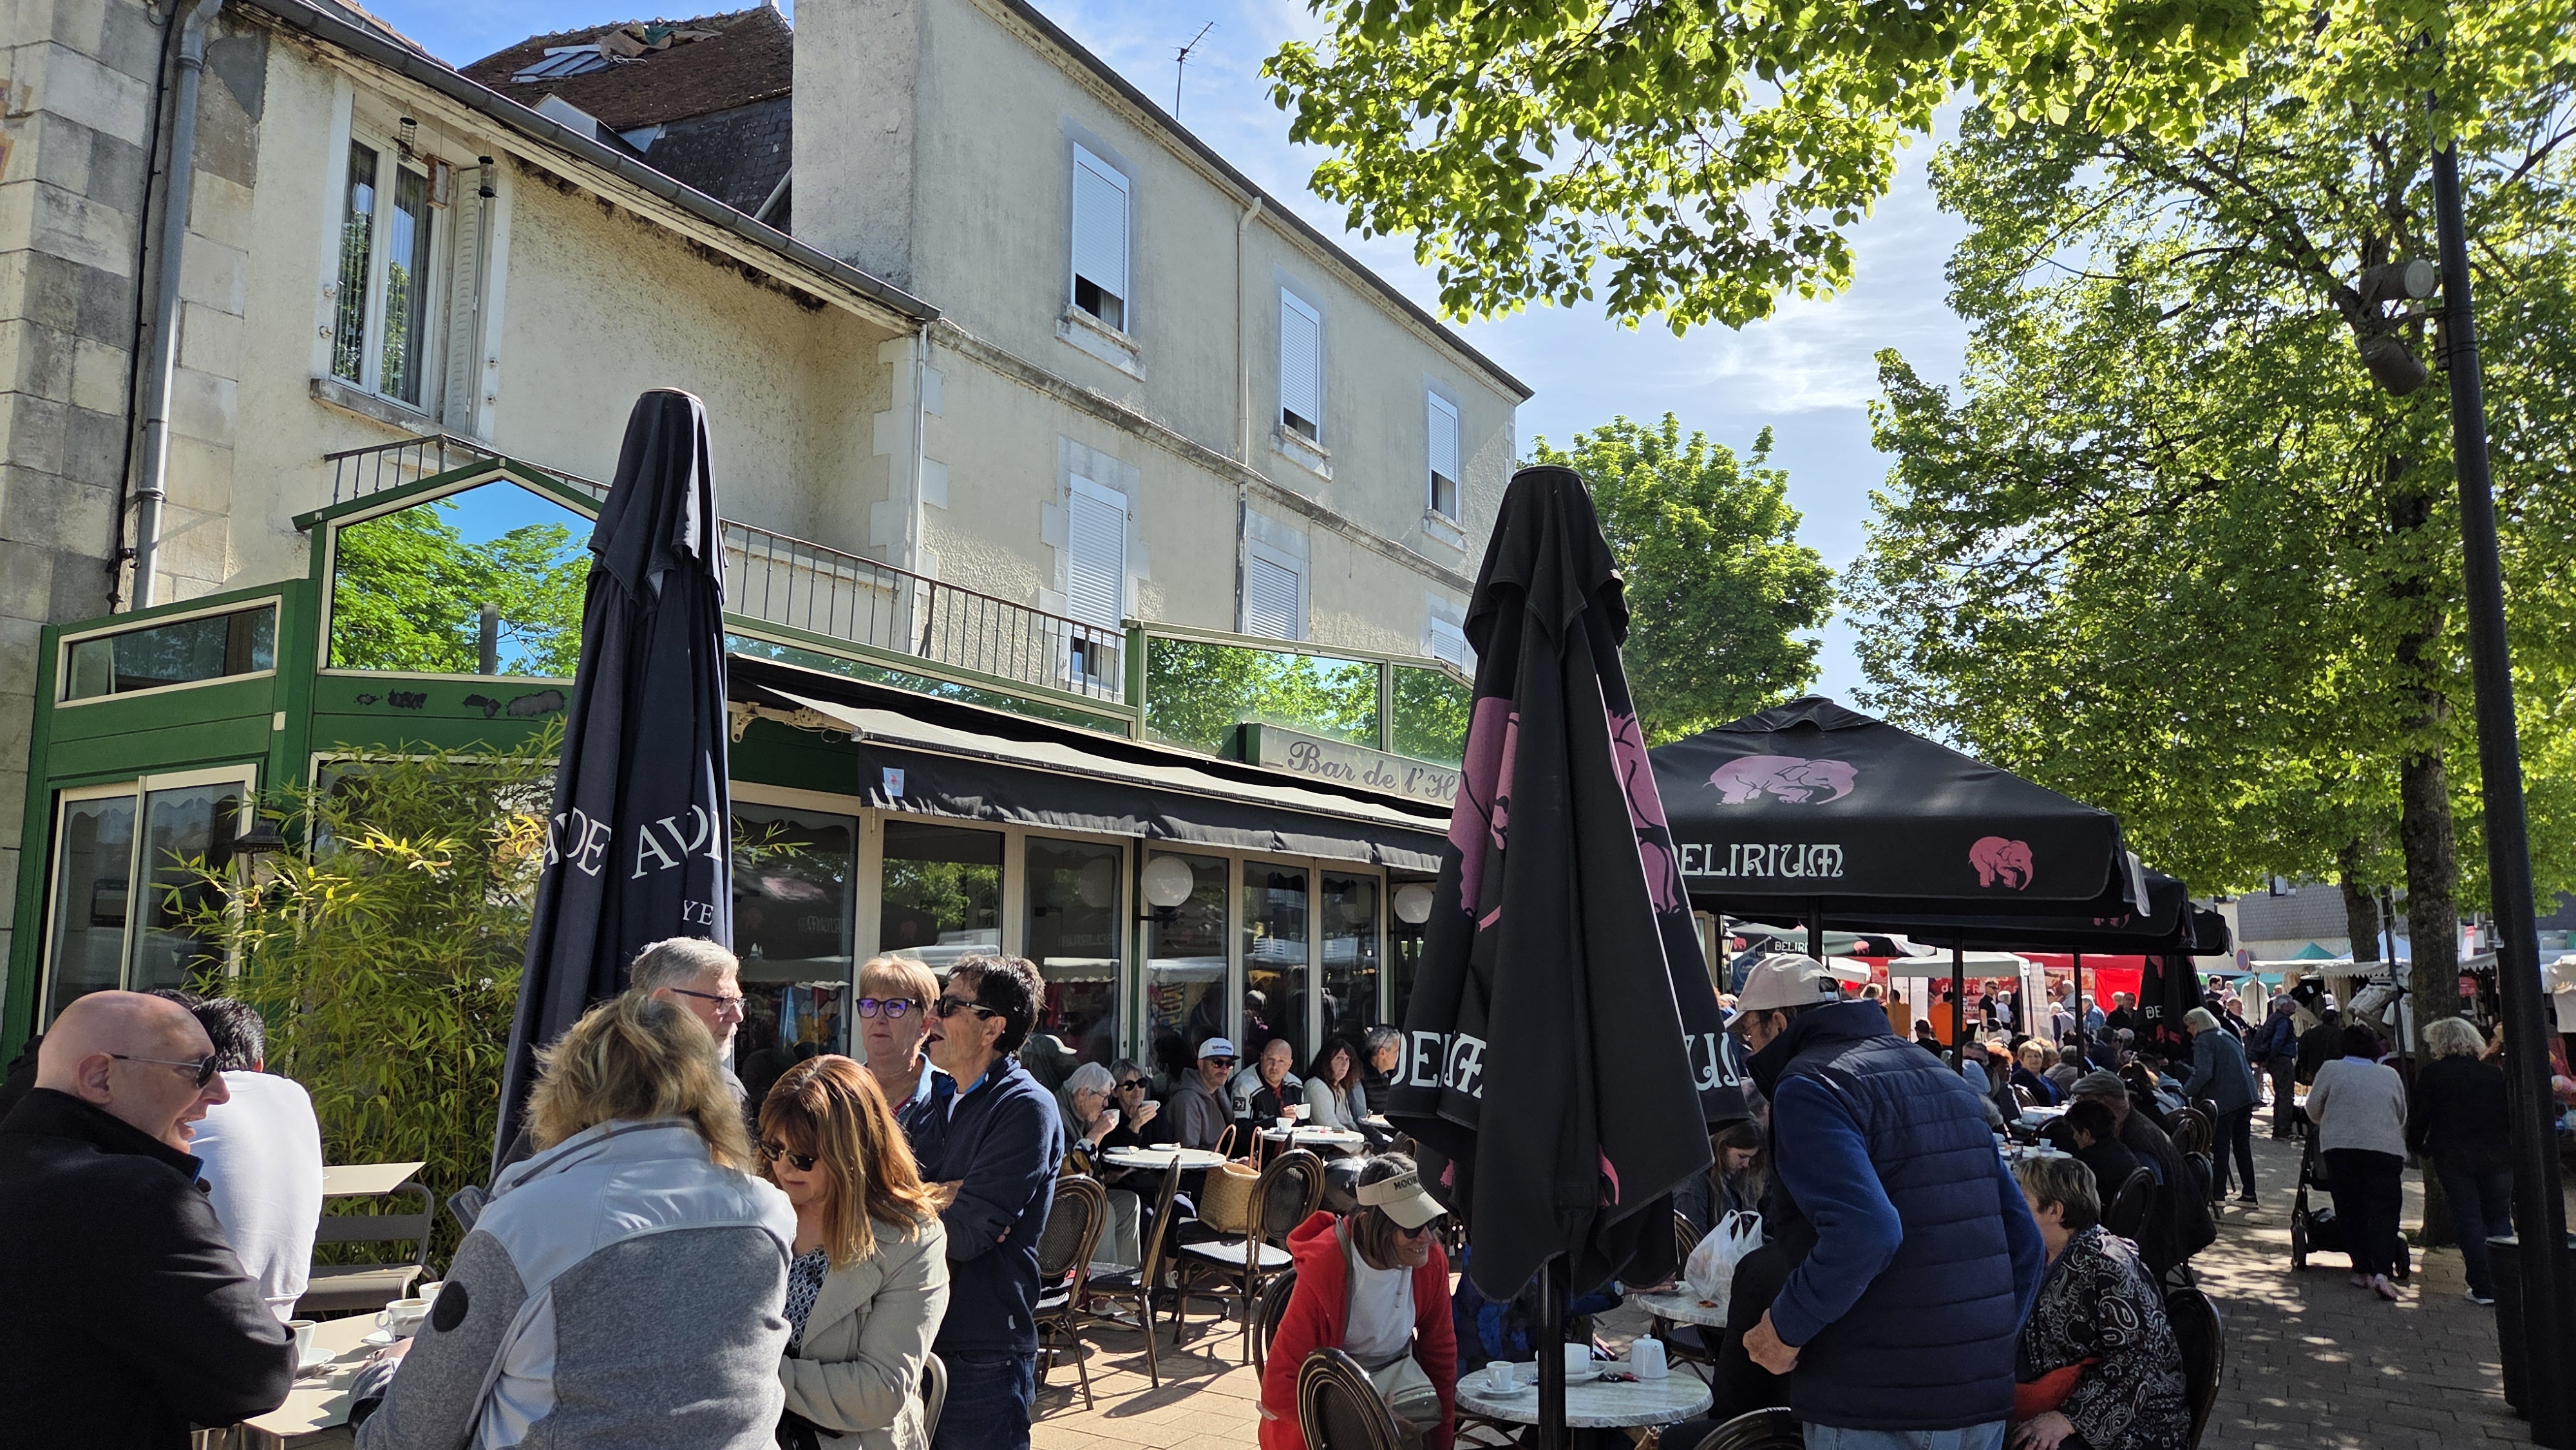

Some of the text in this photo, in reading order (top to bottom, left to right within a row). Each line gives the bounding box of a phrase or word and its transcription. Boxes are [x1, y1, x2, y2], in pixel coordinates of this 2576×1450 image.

[1288, 741, 1356, 782] Bar
[1363, 760, 1396, 789] de
[1672, 843, 1844, 878] ELIRIUM
